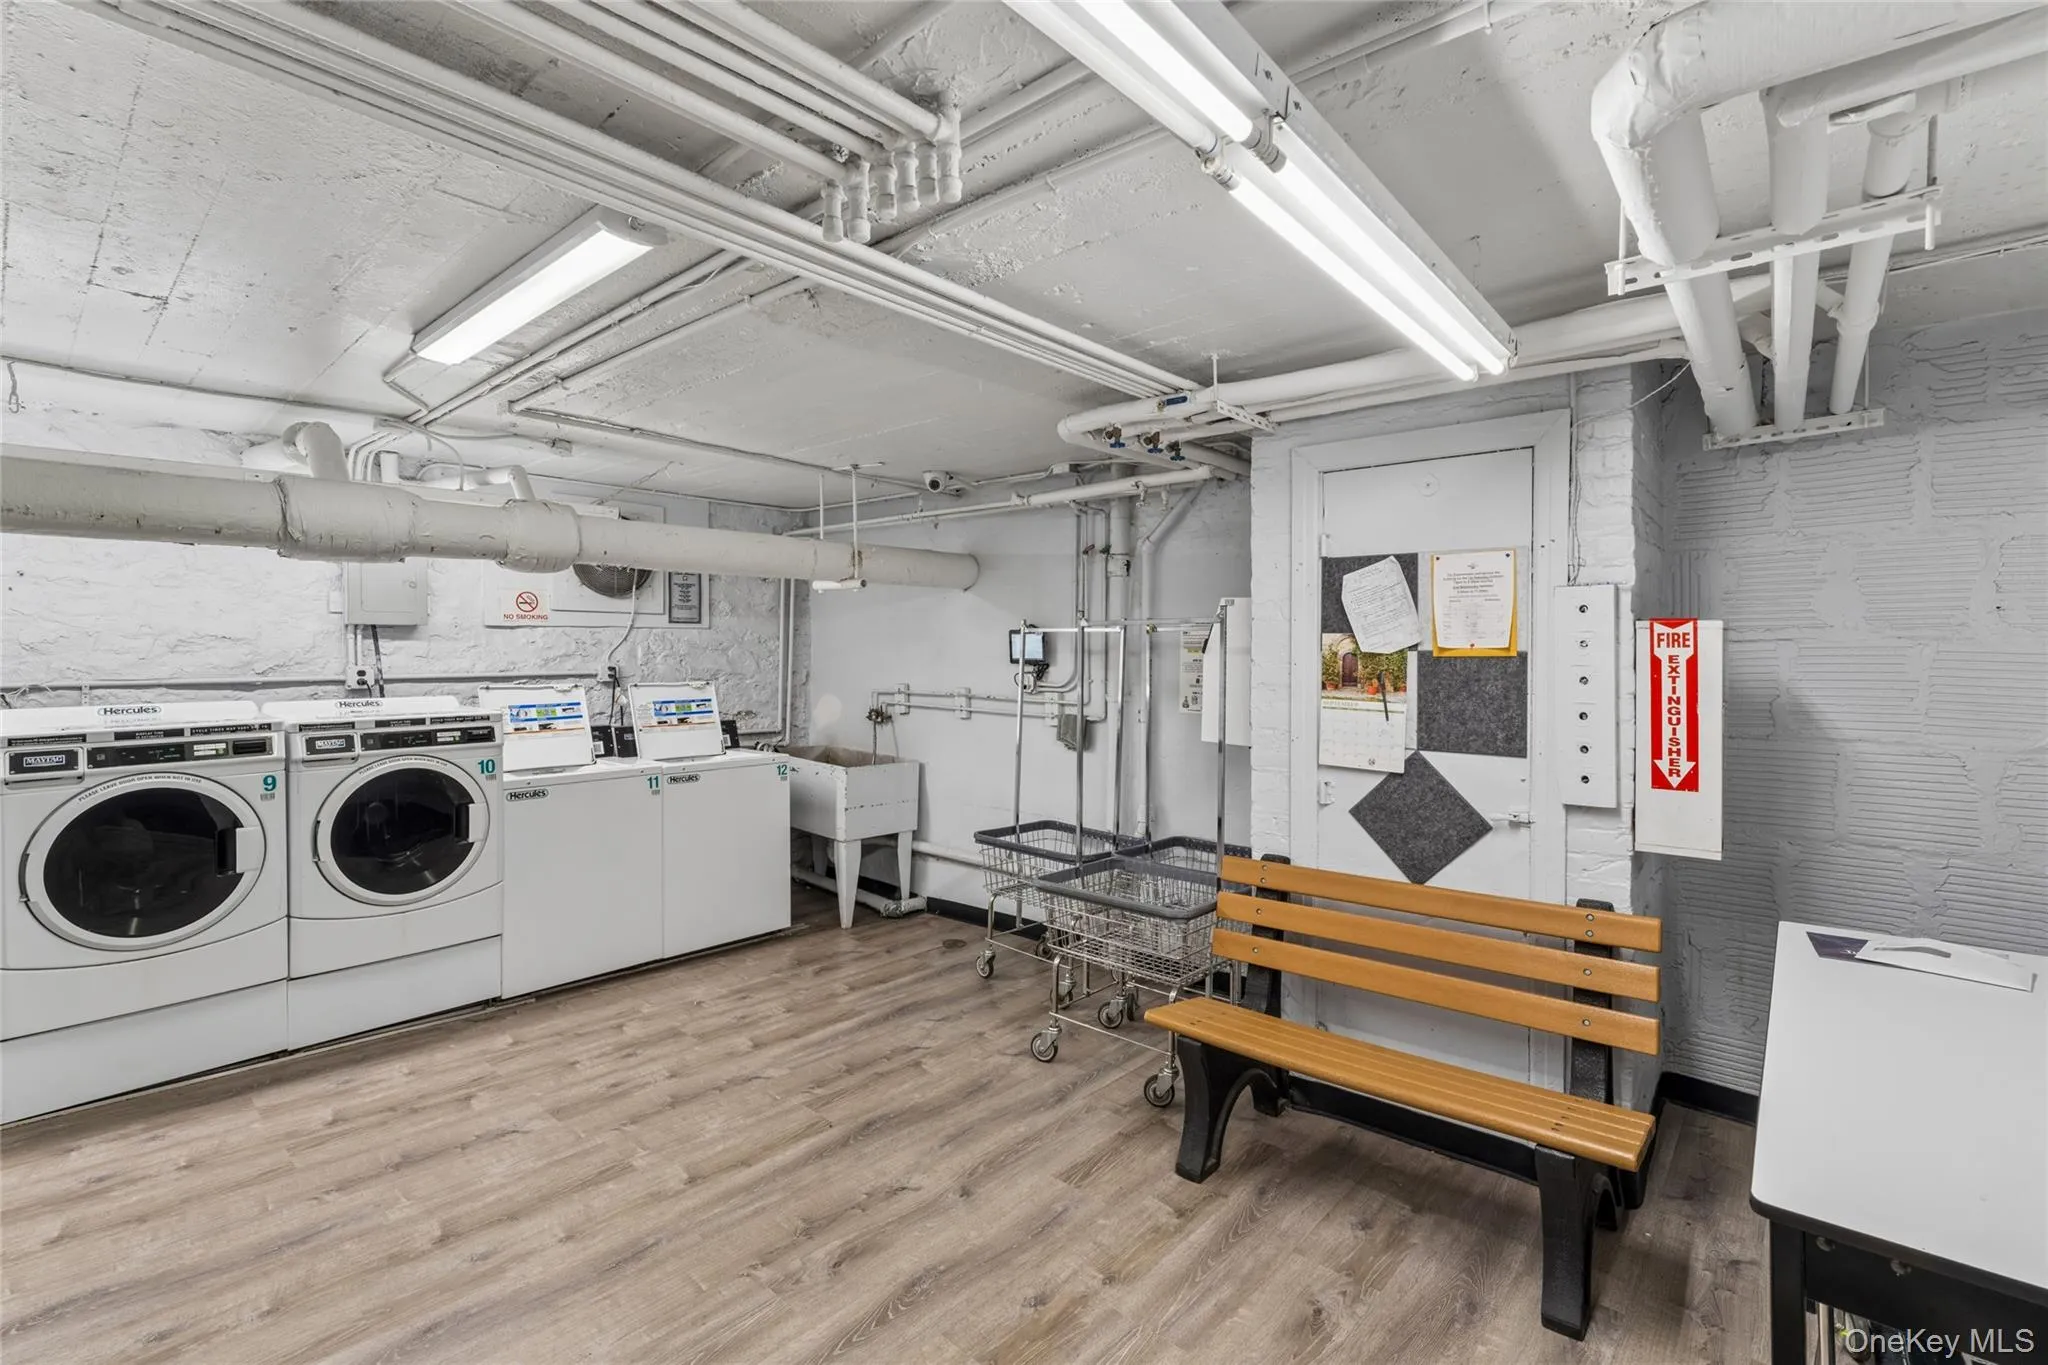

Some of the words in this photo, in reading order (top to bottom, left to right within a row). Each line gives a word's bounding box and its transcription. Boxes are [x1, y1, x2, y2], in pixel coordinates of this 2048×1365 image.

[1656, 632, 1690, 648] FIRE
[103, 705, 158, 716] Hercules
[338, 700, 381, 708] Hercules
[1667, 654, 1682, 778] EXTINGUISHER
[26, 756, 64, 764] MAYTAG
[478, 759, 496, 775] 10
[776, 764, 788, 776] 12
[262, 774, 278, 792] 9
[647, 776, 660, 790] 11
[670, 774, 698, 784] Hercules
[78, 790, 99, 802] PLEASE
[100, 783, 118, 792] LEAVE
[509, 790, 546, 801] Hercules
